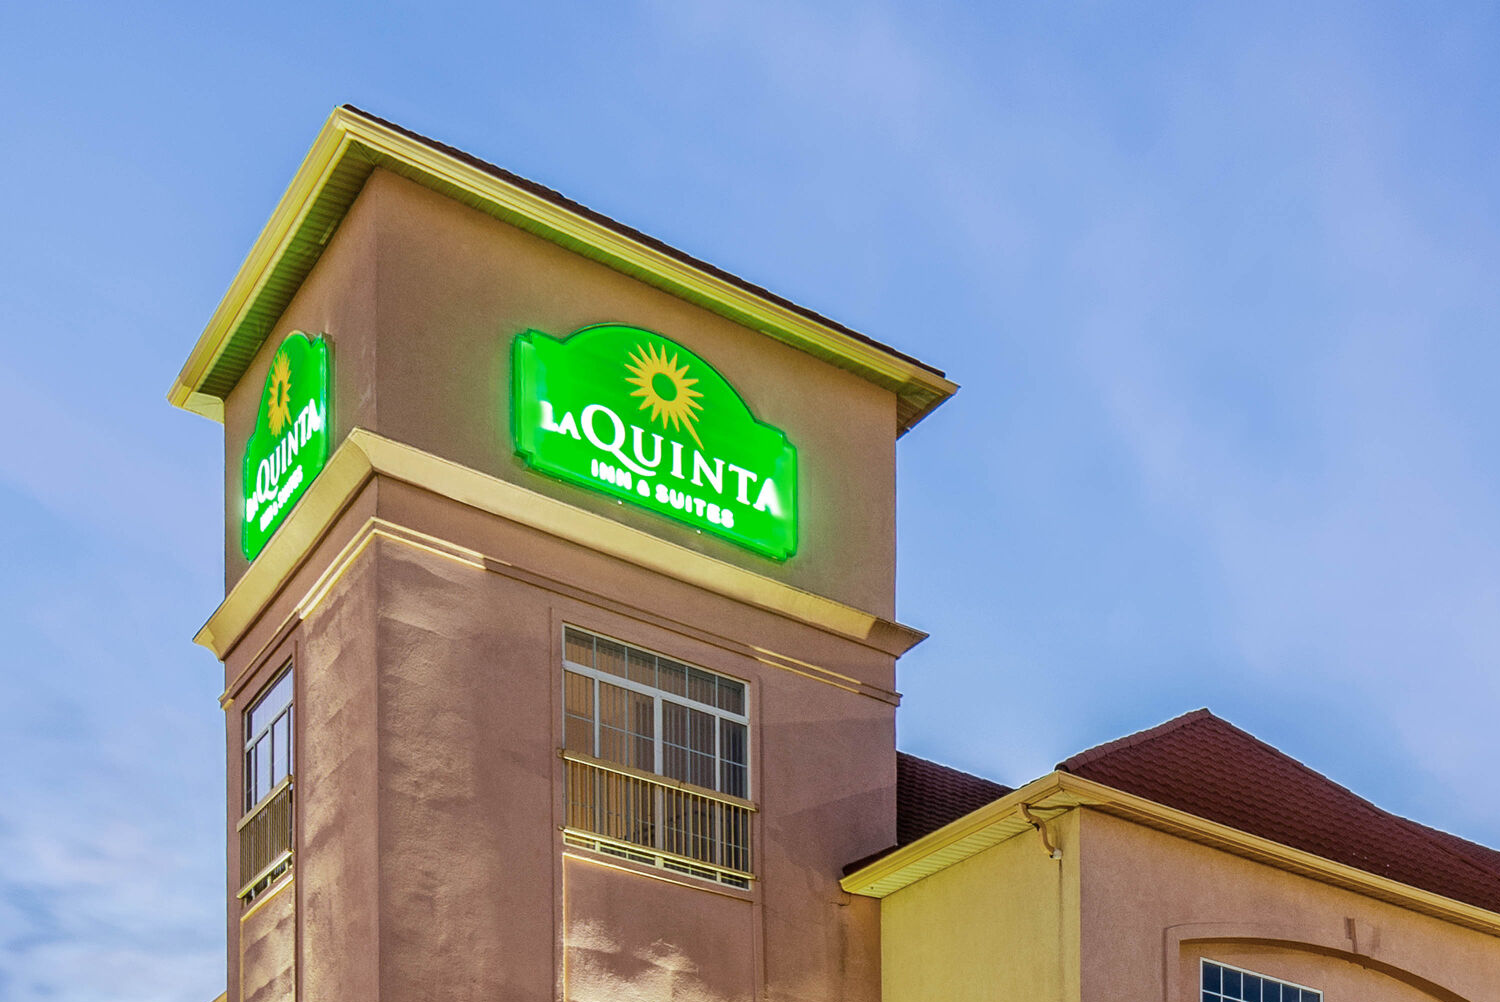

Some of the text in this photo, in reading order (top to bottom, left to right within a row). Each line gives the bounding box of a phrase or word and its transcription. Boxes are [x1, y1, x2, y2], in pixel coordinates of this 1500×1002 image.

[256, 398, 324, 504] QUINTA
[580, 403, 786, 519] QUINTA
[590, 458, 633, 490] INN
[654, 484, 735, 529] SUITES
